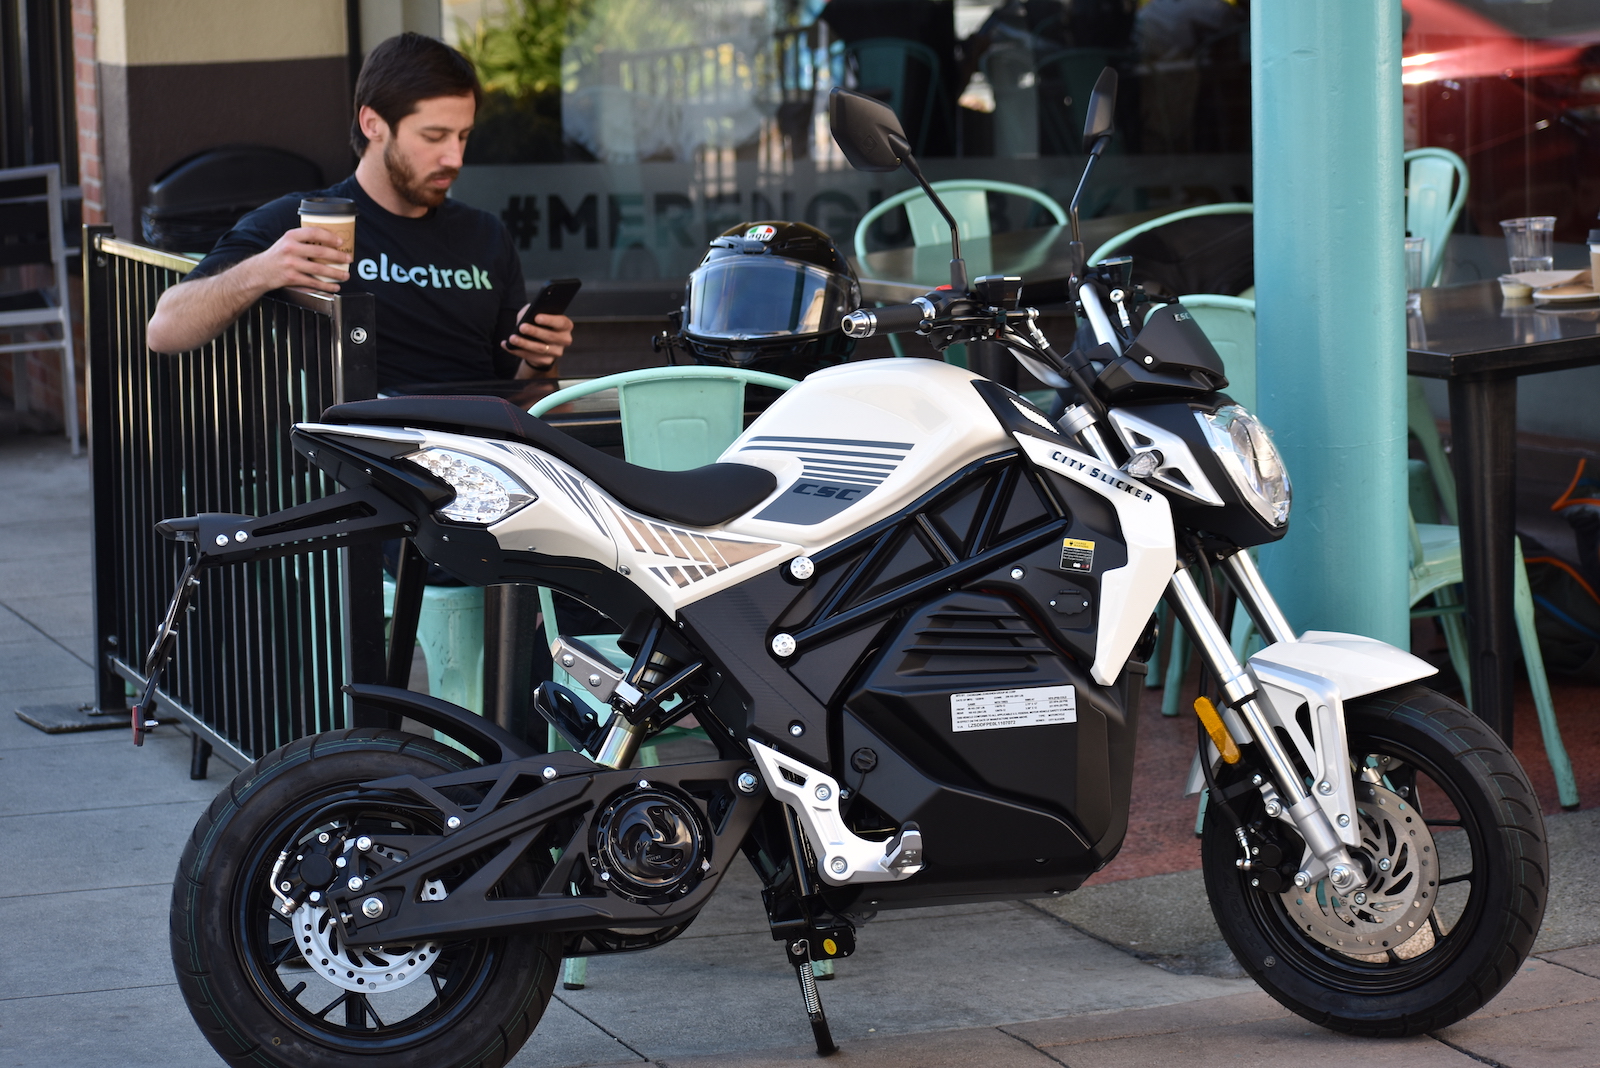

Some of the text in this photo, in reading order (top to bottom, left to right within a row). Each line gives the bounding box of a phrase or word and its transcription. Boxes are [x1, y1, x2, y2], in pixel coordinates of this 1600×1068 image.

[357, 252, 493, 290] electrek
[792, 483, 862, 501] CSC
[1052, 451, 1153, 502] CITY SLICKER
